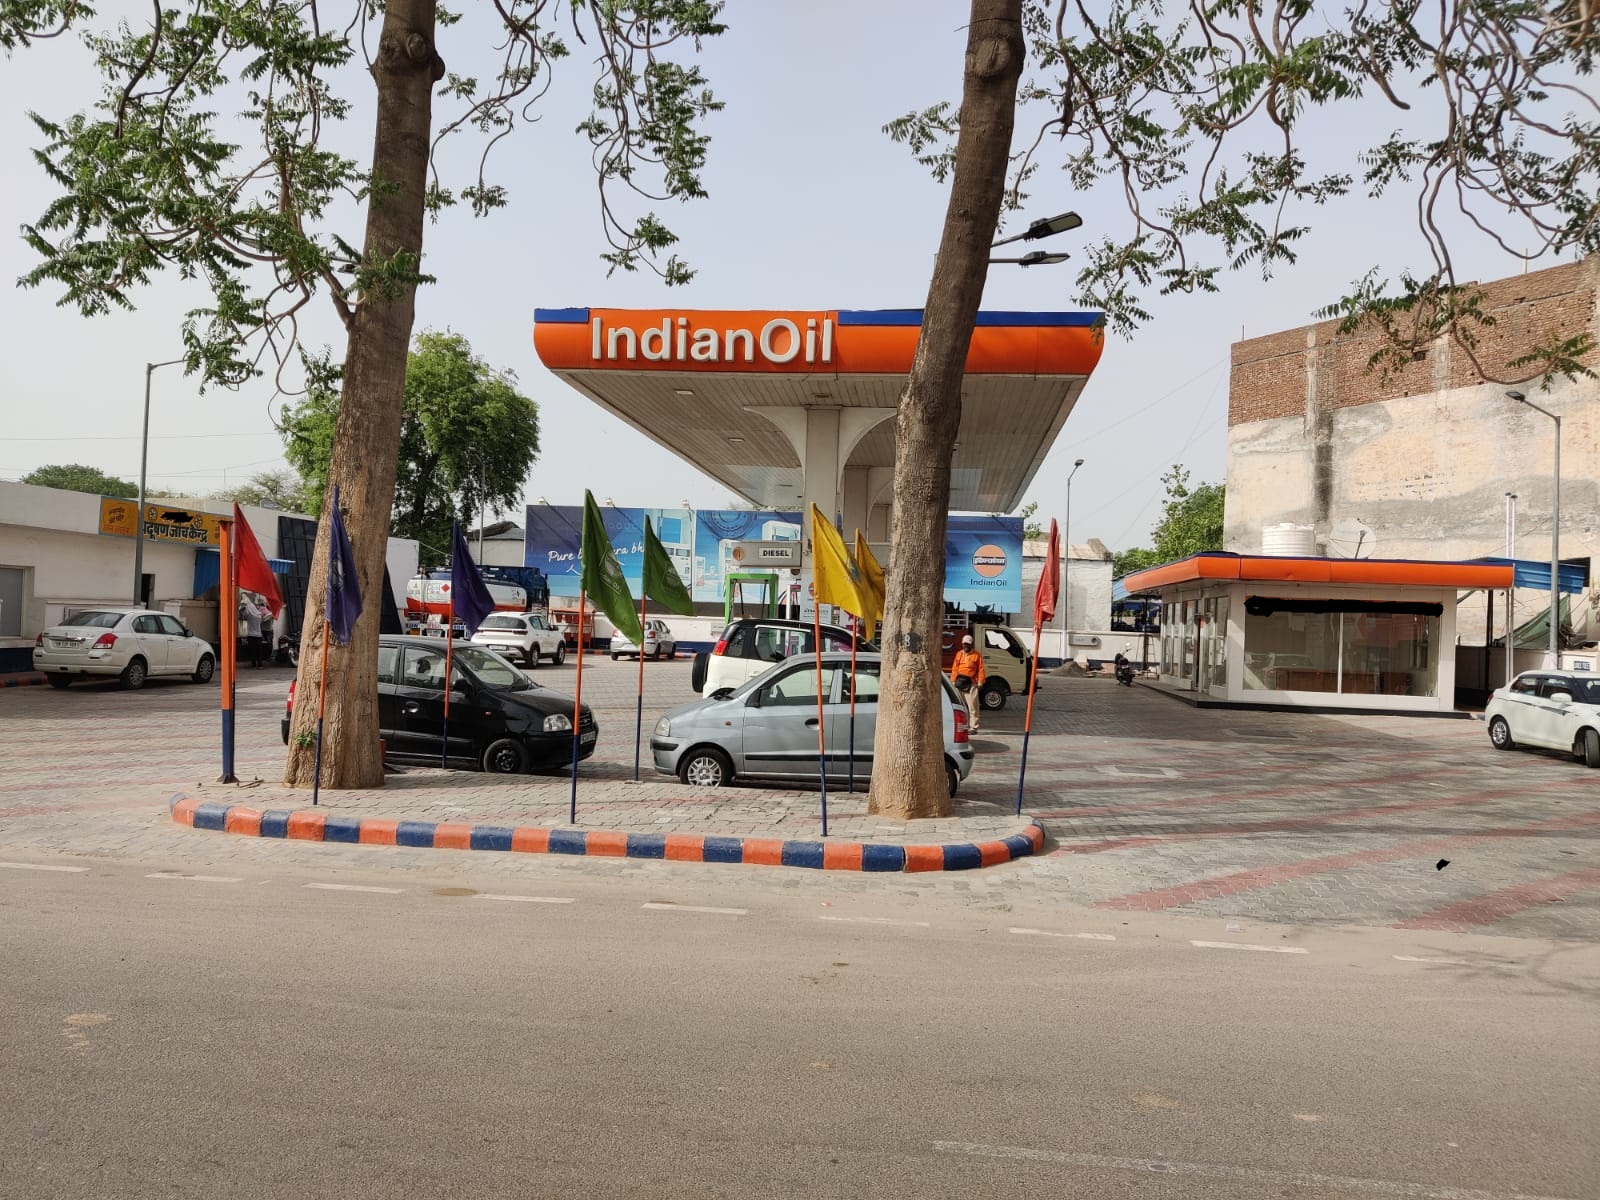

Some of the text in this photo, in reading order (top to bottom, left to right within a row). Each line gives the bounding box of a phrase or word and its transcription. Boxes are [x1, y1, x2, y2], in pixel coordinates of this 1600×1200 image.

[592, 317, 832, 363] IndianOil
[547, 550, 575, 563] Pure
[762, 549, 790, 557] DIESEL
[970, 578, 1007, 587] IndianOil
